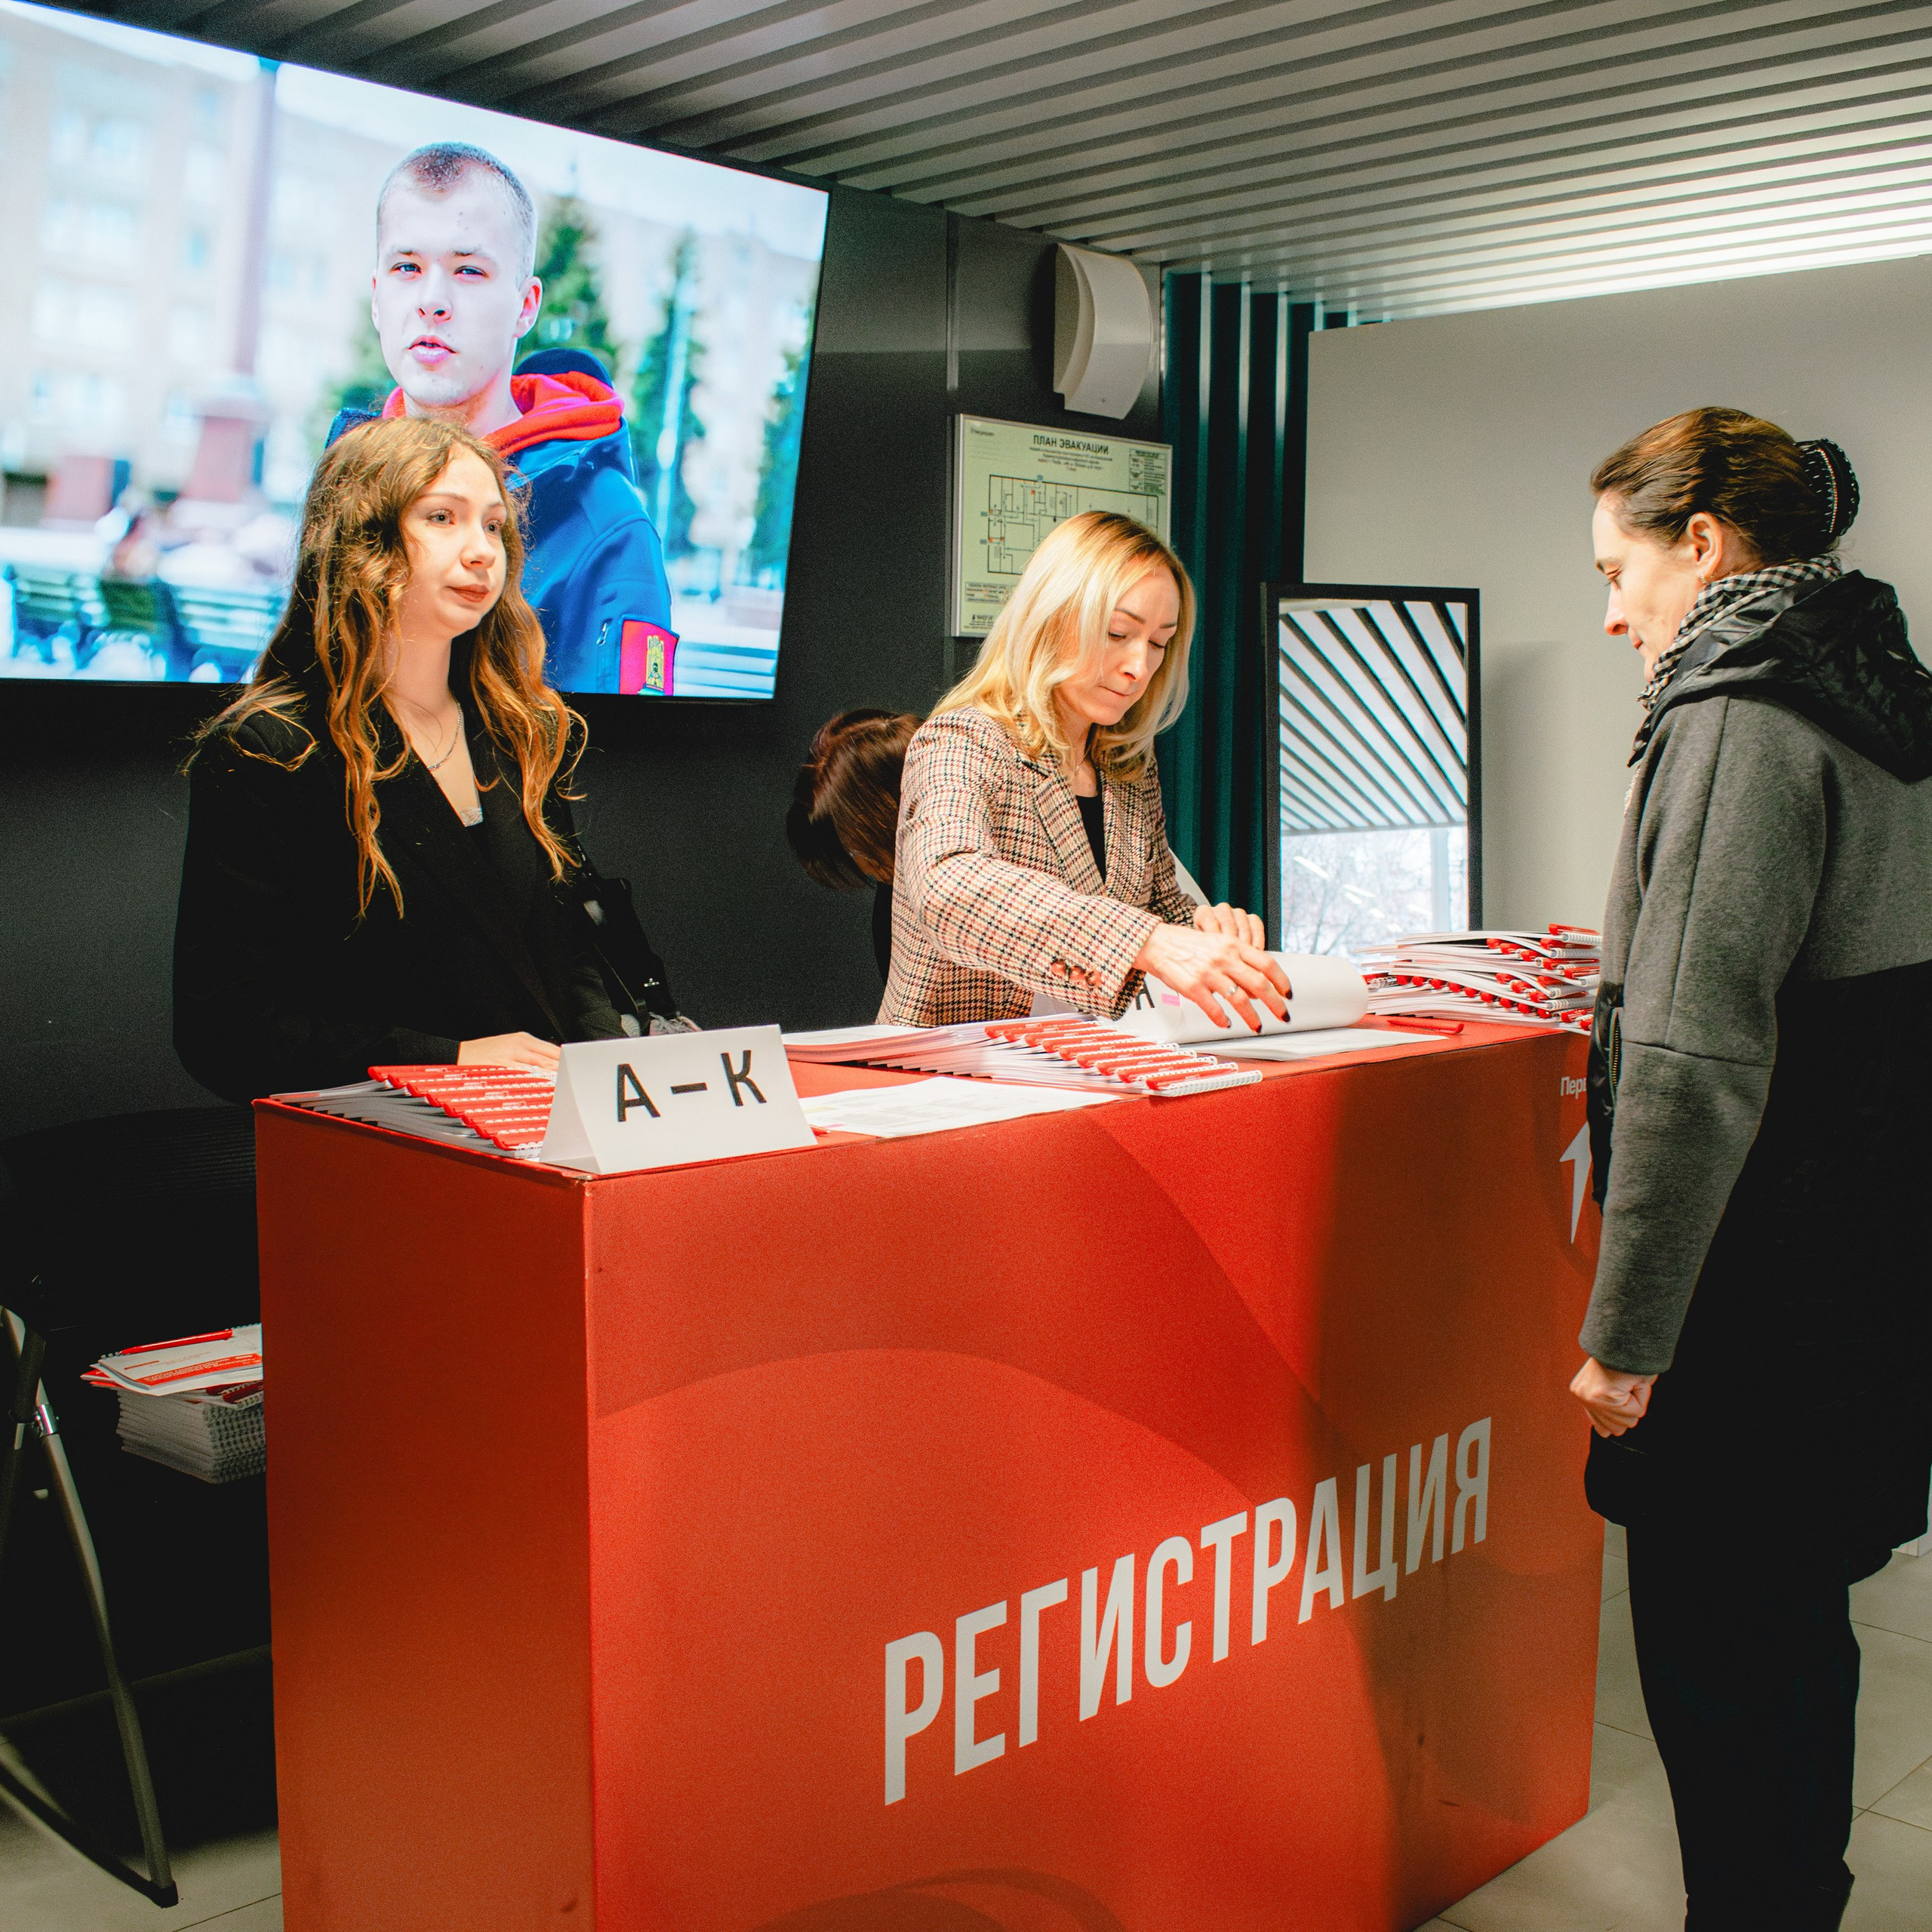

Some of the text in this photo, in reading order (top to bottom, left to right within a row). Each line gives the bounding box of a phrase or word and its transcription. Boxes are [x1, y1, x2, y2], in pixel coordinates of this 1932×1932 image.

[1033, 435, 1057, 447] ПЛАН
[1060, 438, 1109, 454] ЭВАКУАЦИИ
[617, 1063, 661, 1122] А
[721, 1049, 768, 1107] К
[884, 1417, 1493, 1807] РЕГИСТРАЦИЯ
